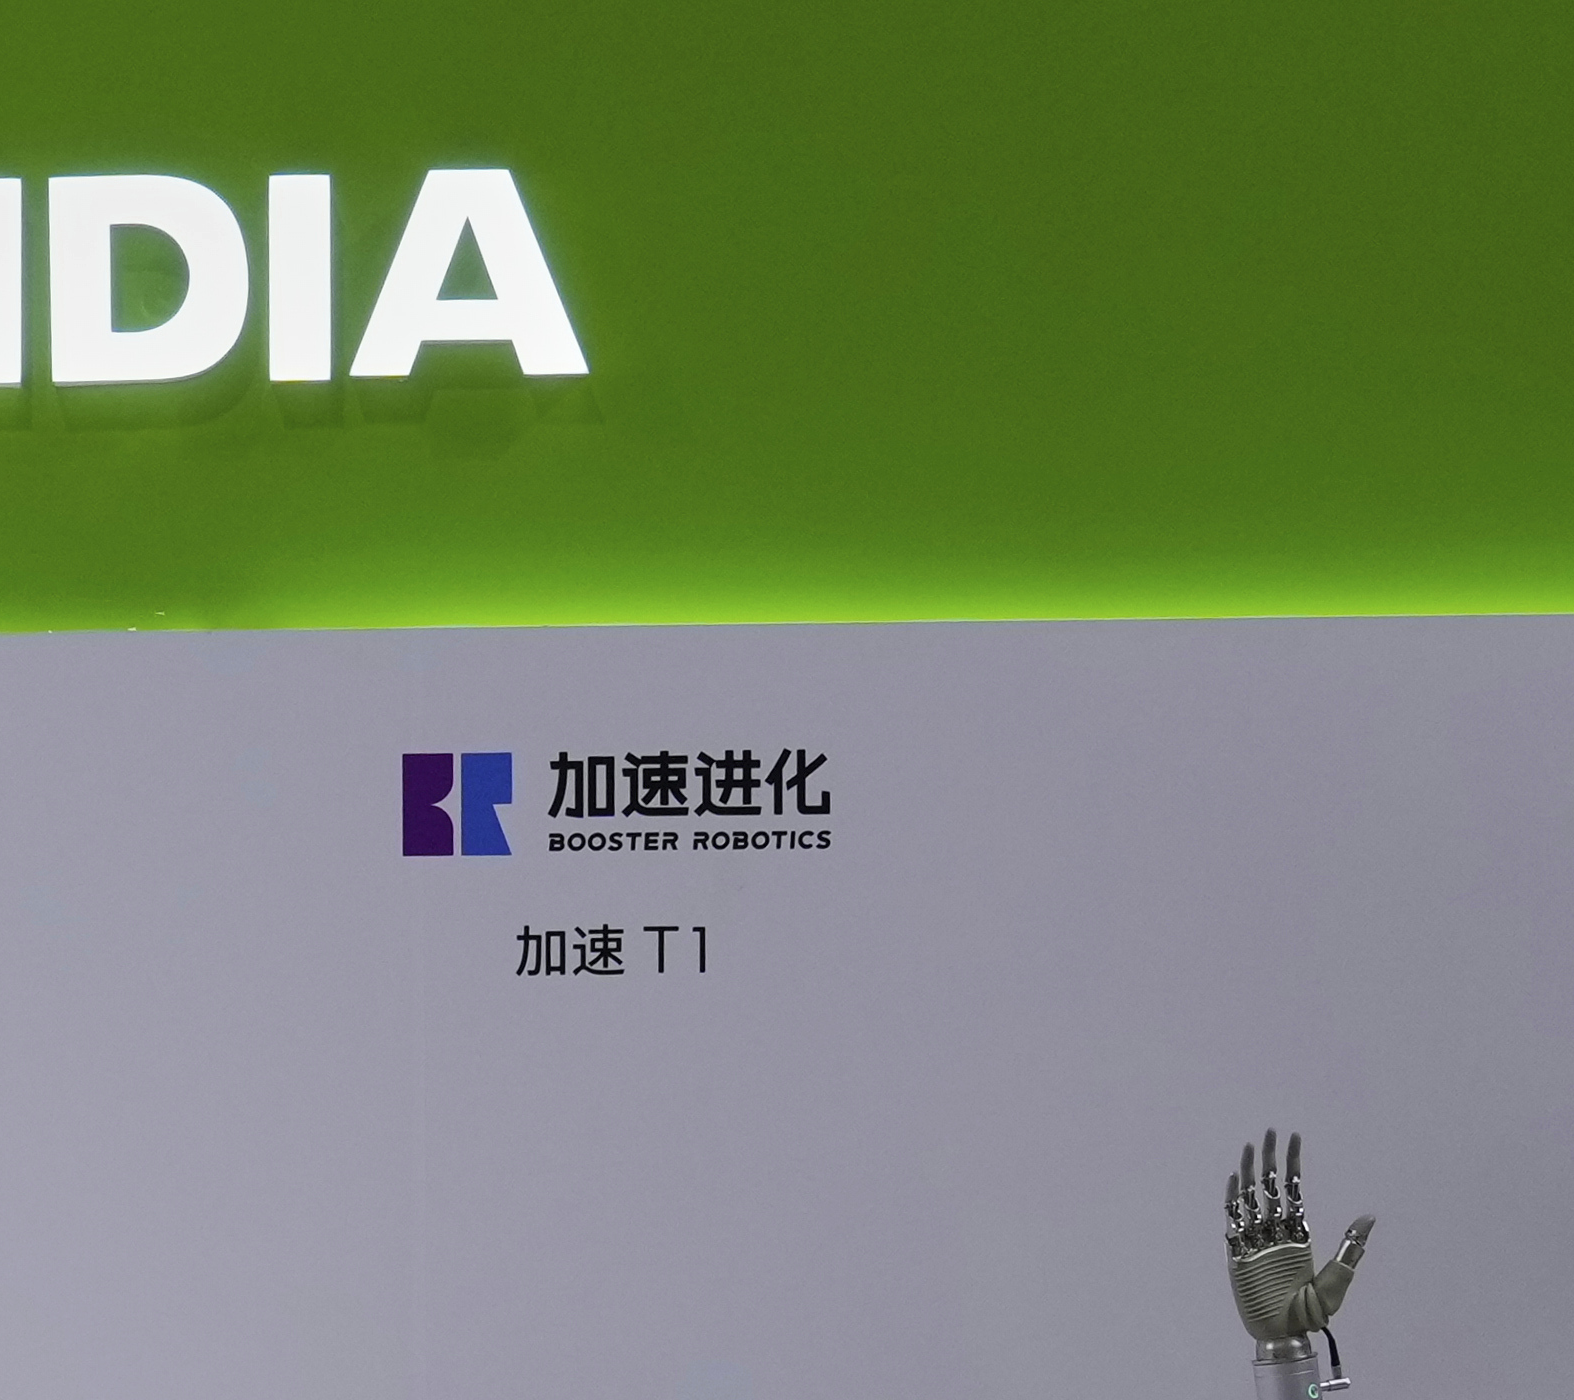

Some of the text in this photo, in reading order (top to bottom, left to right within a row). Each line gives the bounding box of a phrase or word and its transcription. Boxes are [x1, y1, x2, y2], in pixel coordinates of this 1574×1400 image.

[548, 748, 832, 820] 加速进化
[549, 830, 833, 853] BOOSTER ROBOTICS
[516, 924, 708, 978] 加速 T1
